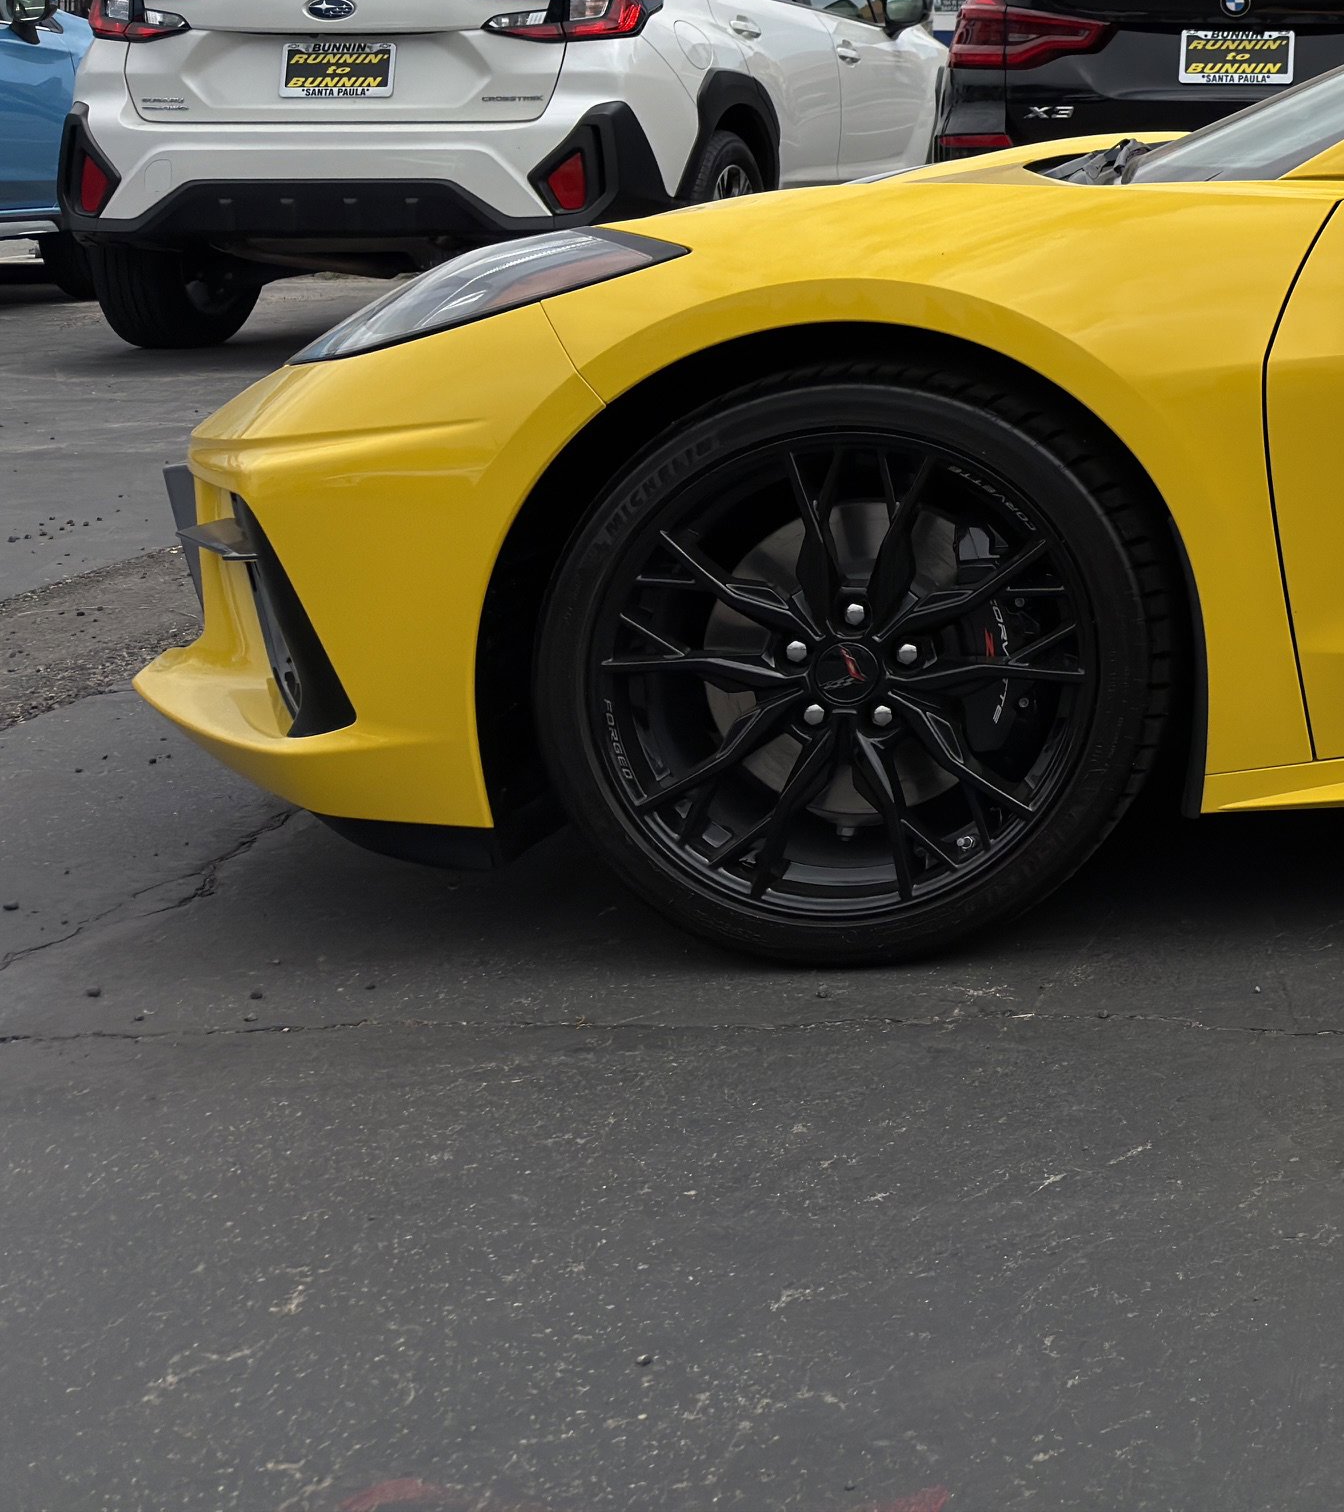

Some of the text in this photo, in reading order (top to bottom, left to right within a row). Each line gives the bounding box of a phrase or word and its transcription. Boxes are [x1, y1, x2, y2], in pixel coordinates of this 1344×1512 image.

[312, 43, 367, 52] BUNNIN
[1188, 40, 1288, 50] RUNNIN'
[289, 53, 390, 64] RUNNIN'
[1225, 52, 1251, 60] to
[326, 65, 351, 74] to
[1186, 63, 1282, 73] BUNNIN
[287, 77, 383, 87] BUNNIN
[1205, 74, 1267, 83] SANTA PAULA
[1024, 106, 1074, 118] X3
[603, 698, 633, 780] FORGED
